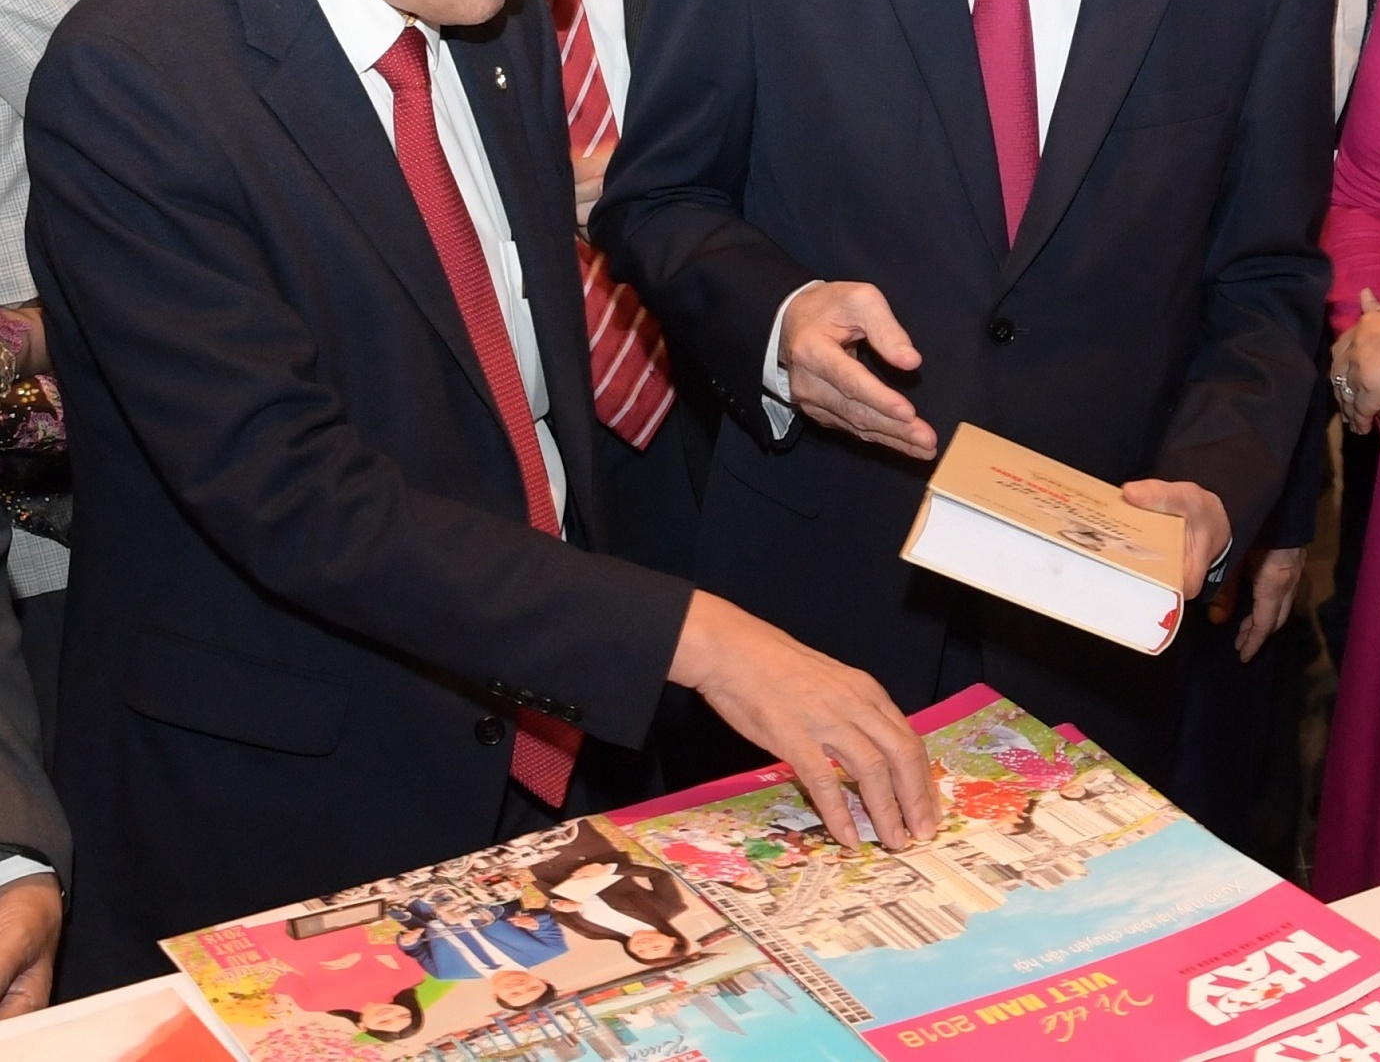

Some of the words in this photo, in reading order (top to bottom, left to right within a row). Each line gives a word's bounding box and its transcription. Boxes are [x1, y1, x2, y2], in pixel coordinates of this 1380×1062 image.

[1047, 971, 1119, 1004] VIỆT
[974, 993, 1048, 1025] NAM
[897, 1014, 977, 1048] 2018
